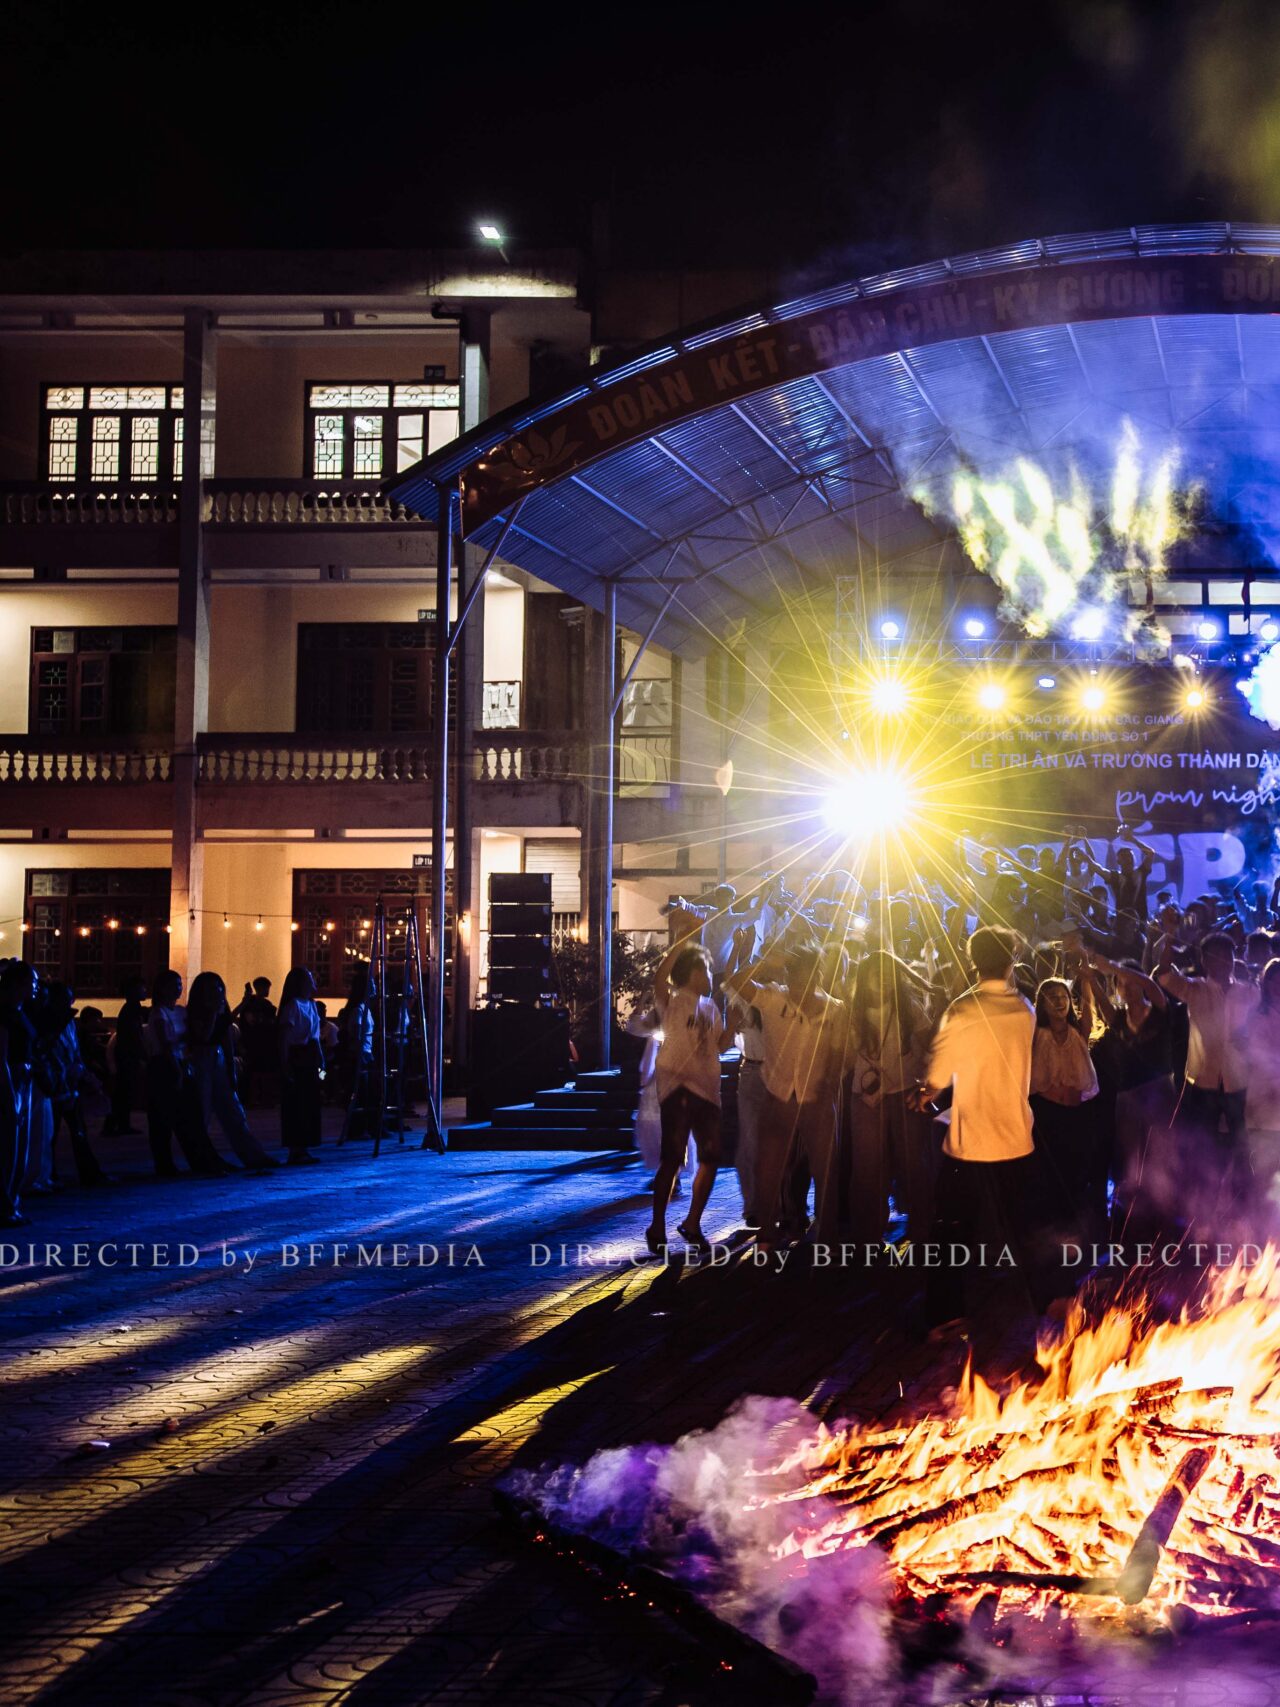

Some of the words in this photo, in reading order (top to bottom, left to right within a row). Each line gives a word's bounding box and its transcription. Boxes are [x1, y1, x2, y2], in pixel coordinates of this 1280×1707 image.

[586, 377, 694, 440] ĐOÀN
[708, 329, 780, 391] KẾT
[896, 281, 971, 337] CHỦ
[1057, 268, 1184, 312] CƯƠNG
[1144, 714, 1185, 725] GIANG
[1018, 730, 1051, 741] THPT
[1055, 728, 1079, 741] YÊN
[998, 752, 1027, 768] TRI
[1031, 749, 1059, 768] ÂN
[1063, 749, 1087, 769] VÀ
[1176, 748, 1241, 769] THÀNH
[1115, 788, 1205, 823] prom
